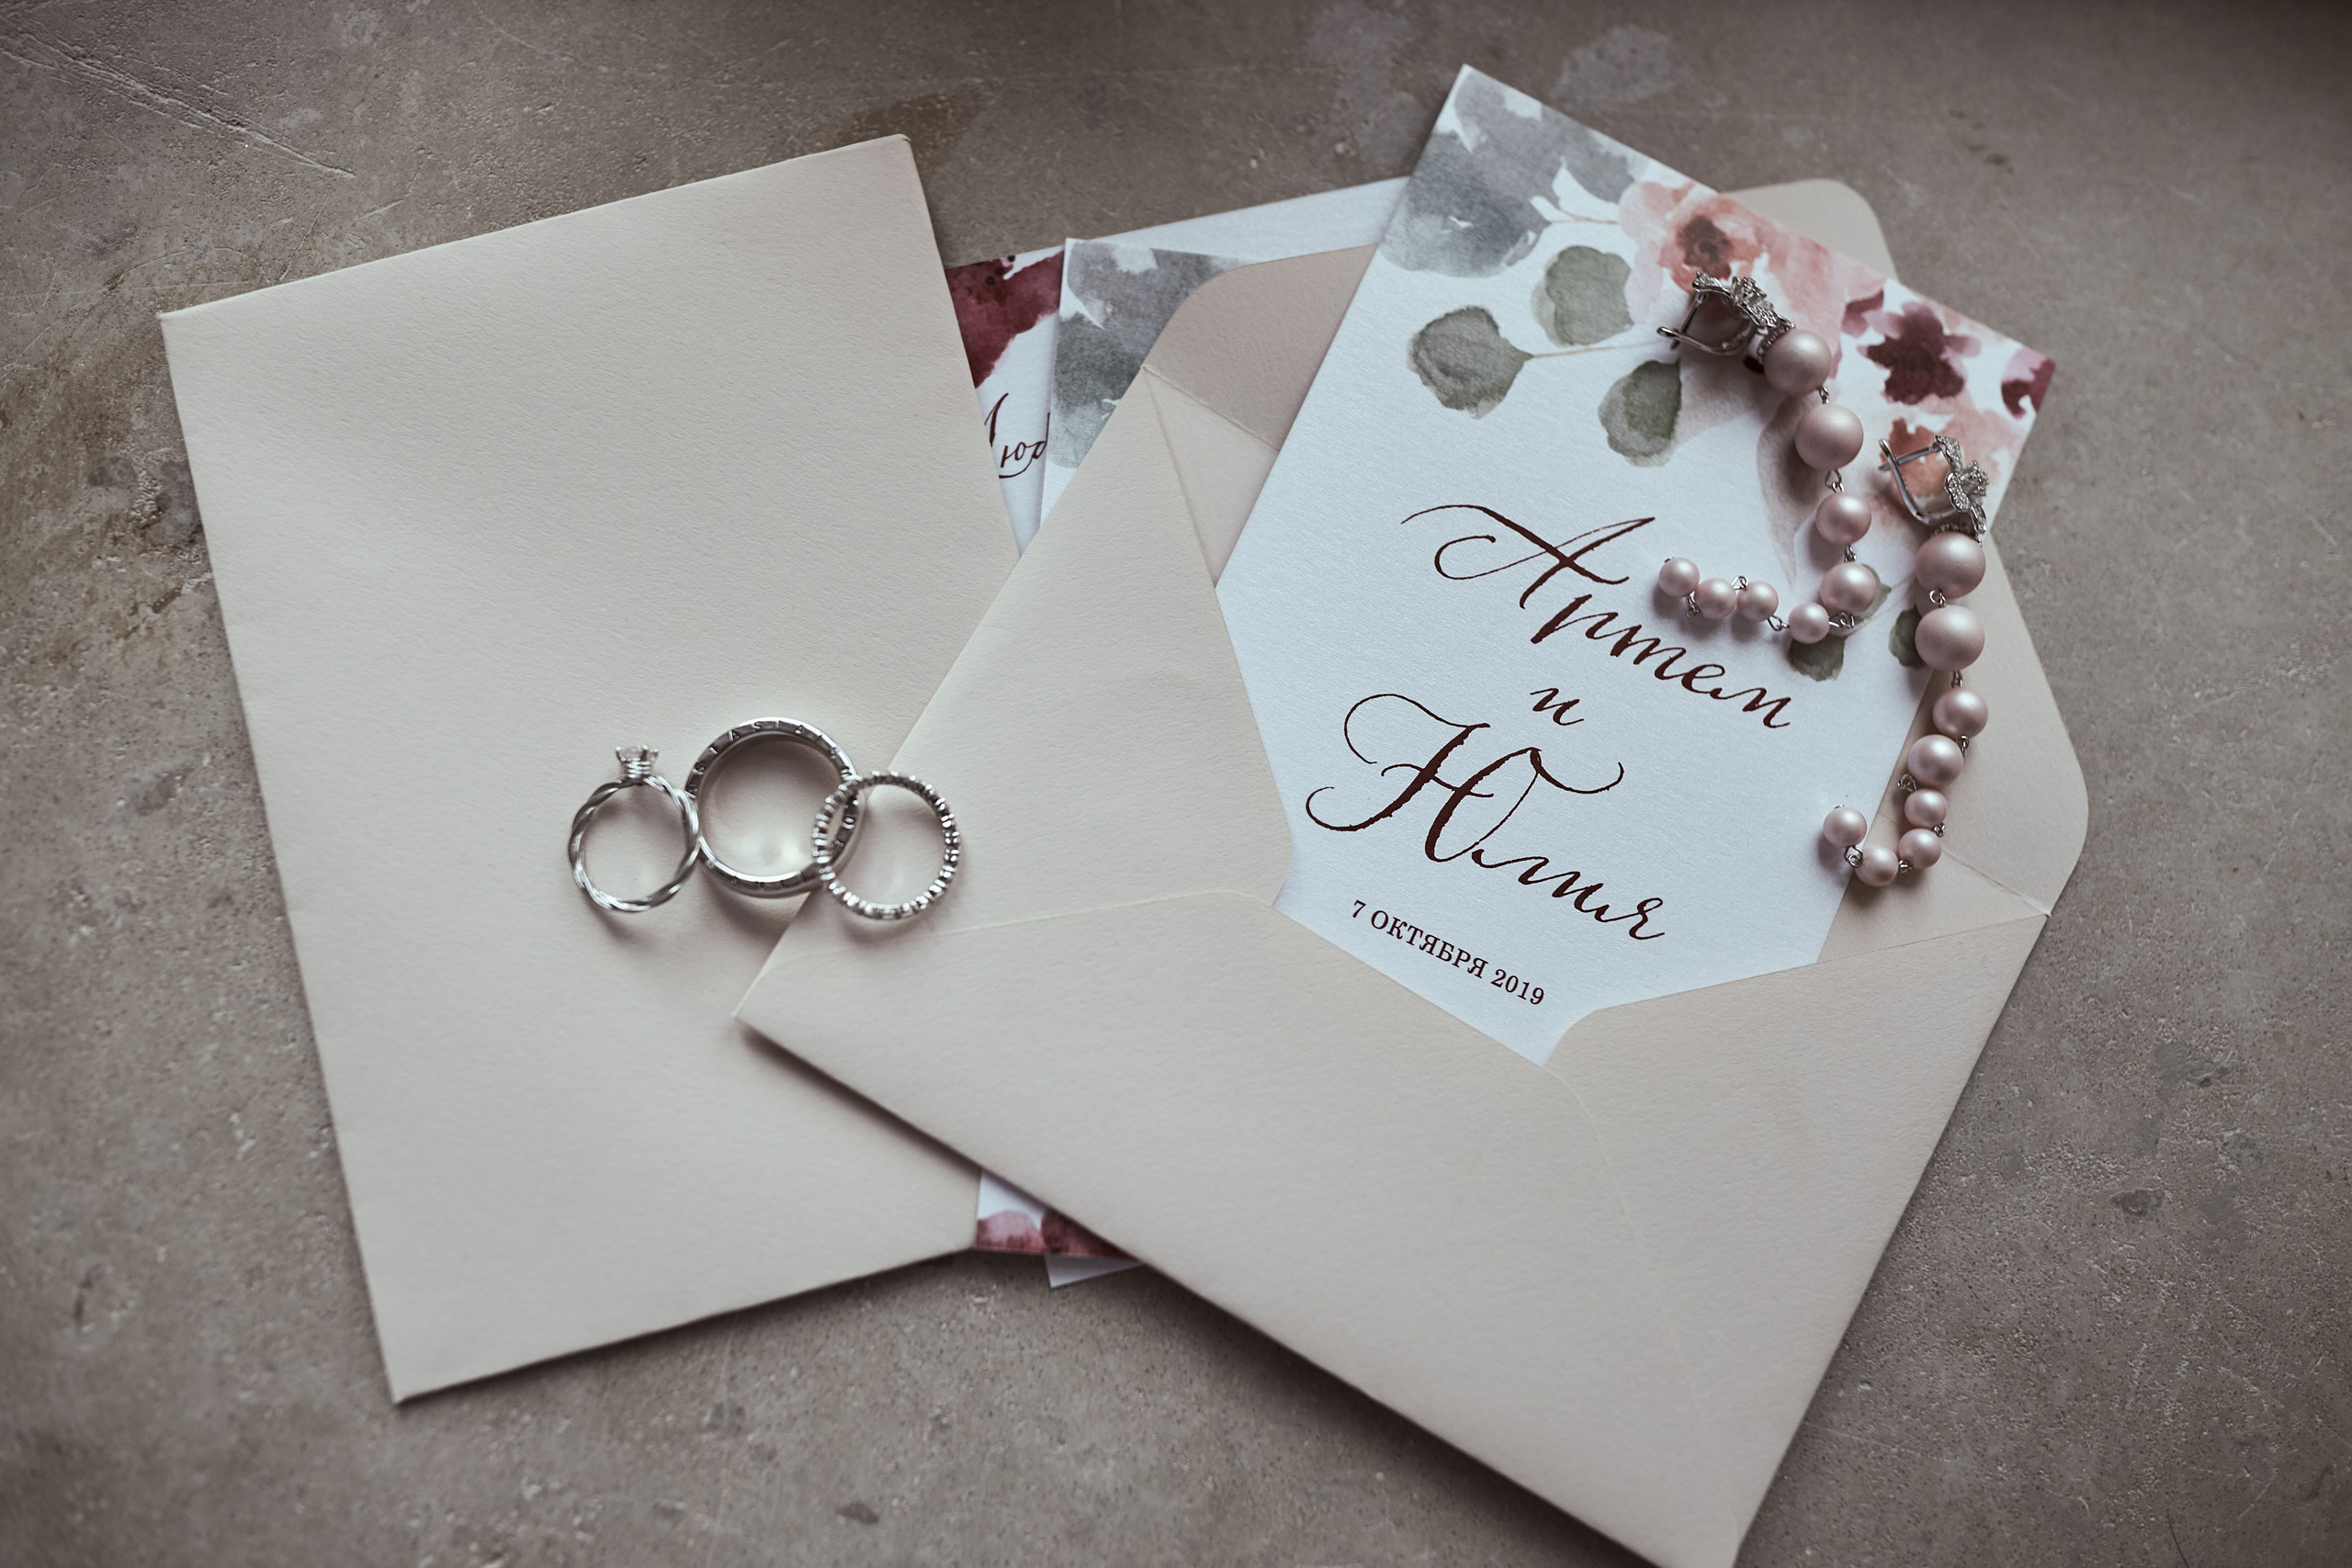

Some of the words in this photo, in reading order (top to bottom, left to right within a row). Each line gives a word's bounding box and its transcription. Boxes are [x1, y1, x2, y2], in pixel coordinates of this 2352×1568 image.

[1401, 504, 1791, 728] Артем
[1529, 687, 1585, 727] и
[1305, 693, 1665, 941] Юлия
[1351, 899, 1367, 919] 7
[1370, 909, 1489, 979] ОКТЯБРЯ
[1490, 968, 1545, 1006] 2019
